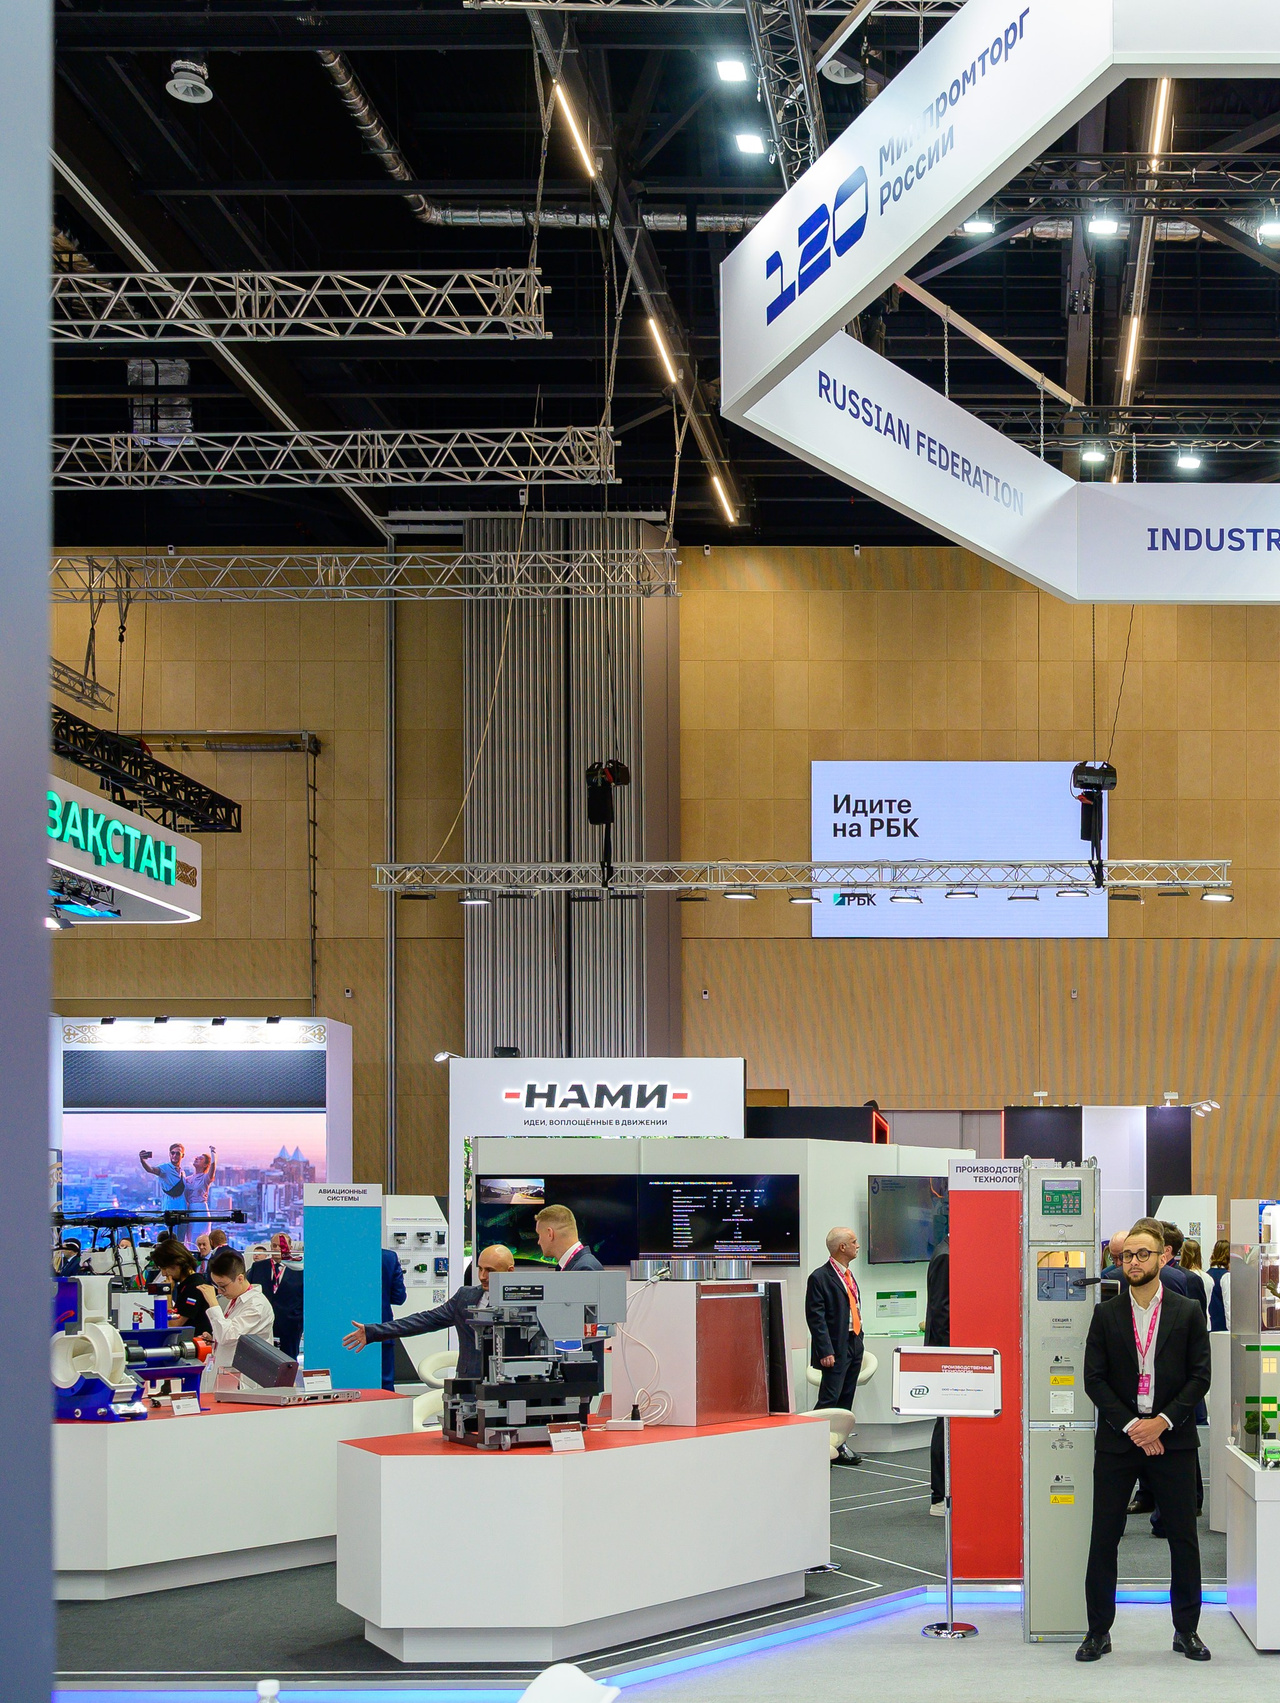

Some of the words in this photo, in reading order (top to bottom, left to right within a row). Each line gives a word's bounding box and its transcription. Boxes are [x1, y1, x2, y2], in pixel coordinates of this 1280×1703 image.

[880, 7, 1030, 177] Мипромторг
[818, 370, 910, 450] RUSSIAN
[916, 430, 1024, 516] FEDERATION
[833, 793, 912, 817] Идите
[832, 819, 862, 838] на
[870, 817, 919, 838] РБК
[525, 1083, 668, 1109] НАМИ
[523, 1119, 548, 1127] ИДЕИ,
[549, 1118, 614, 1127] ВОПЛОЩЁННЫЕ
[621, 1119, 668, 1127] ДВИЖЕНИИ
[973, 1175, 1020, 1183] ТЕХНОЛОГ
